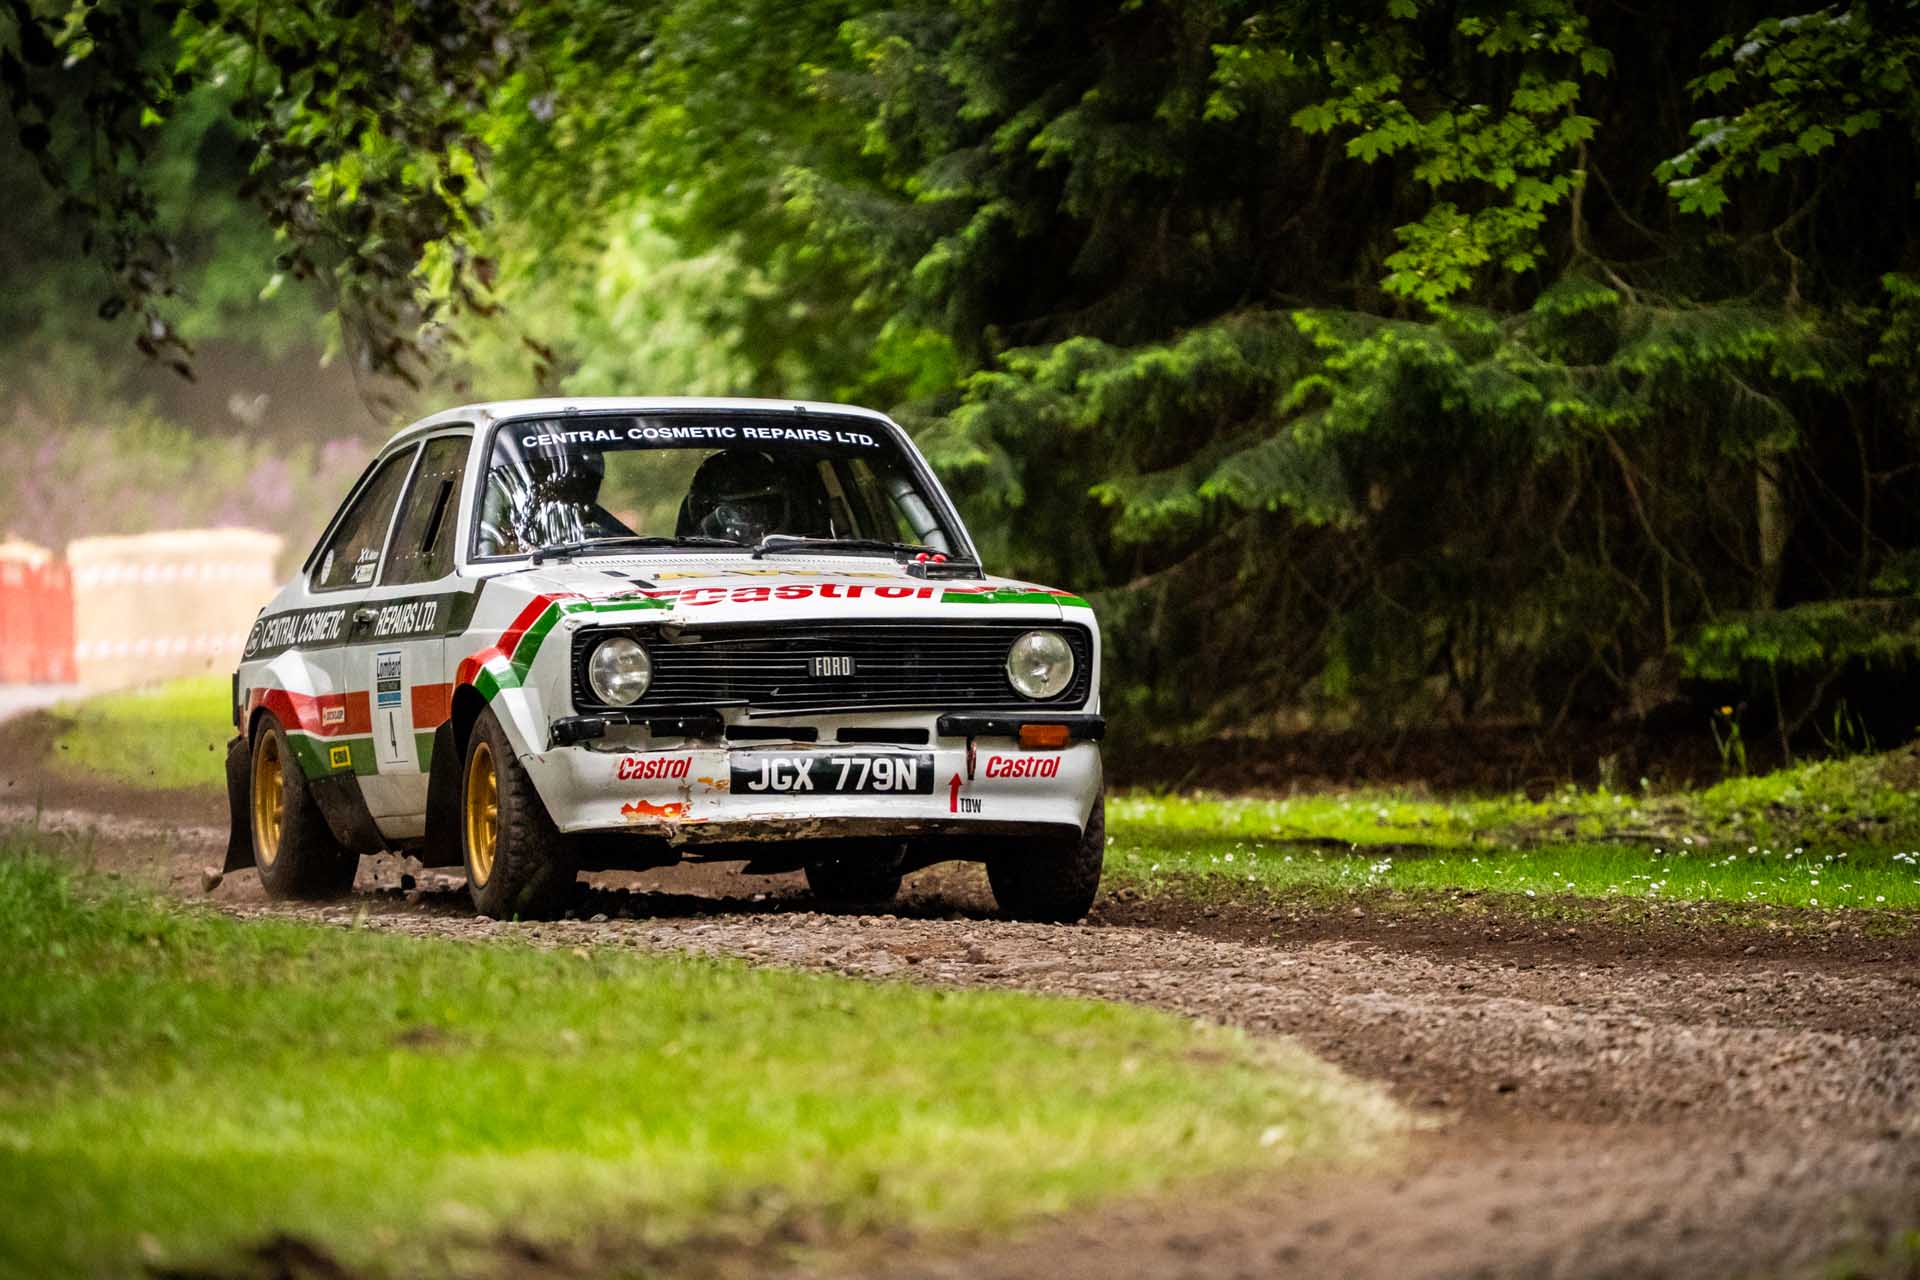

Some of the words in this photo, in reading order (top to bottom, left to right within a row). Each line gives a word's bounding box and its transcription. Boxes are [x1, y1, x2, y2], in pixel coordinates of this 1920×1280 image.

[522, 430, 623, 447] CENTRAL
[628, 427, 736, 440] COSMETIC
[743, 428, 832, 441] REPAIRS
[836, 431, 880, 447] LTD.
[262, 615, 300, 649] CENTRAL
[298, 610, 345, 642] COSMETIC
[375, 607, 416, 636] REPAIRS
[816, 657, 850, 676] FORD
[617, 757, 692, 780] Castrol
[748, 758, 814, 791] JGX
[832, 758, 917, 791] 779N
[986, 756, 1060, 779] Castrol
[960, 798, 982, 813] TOW
